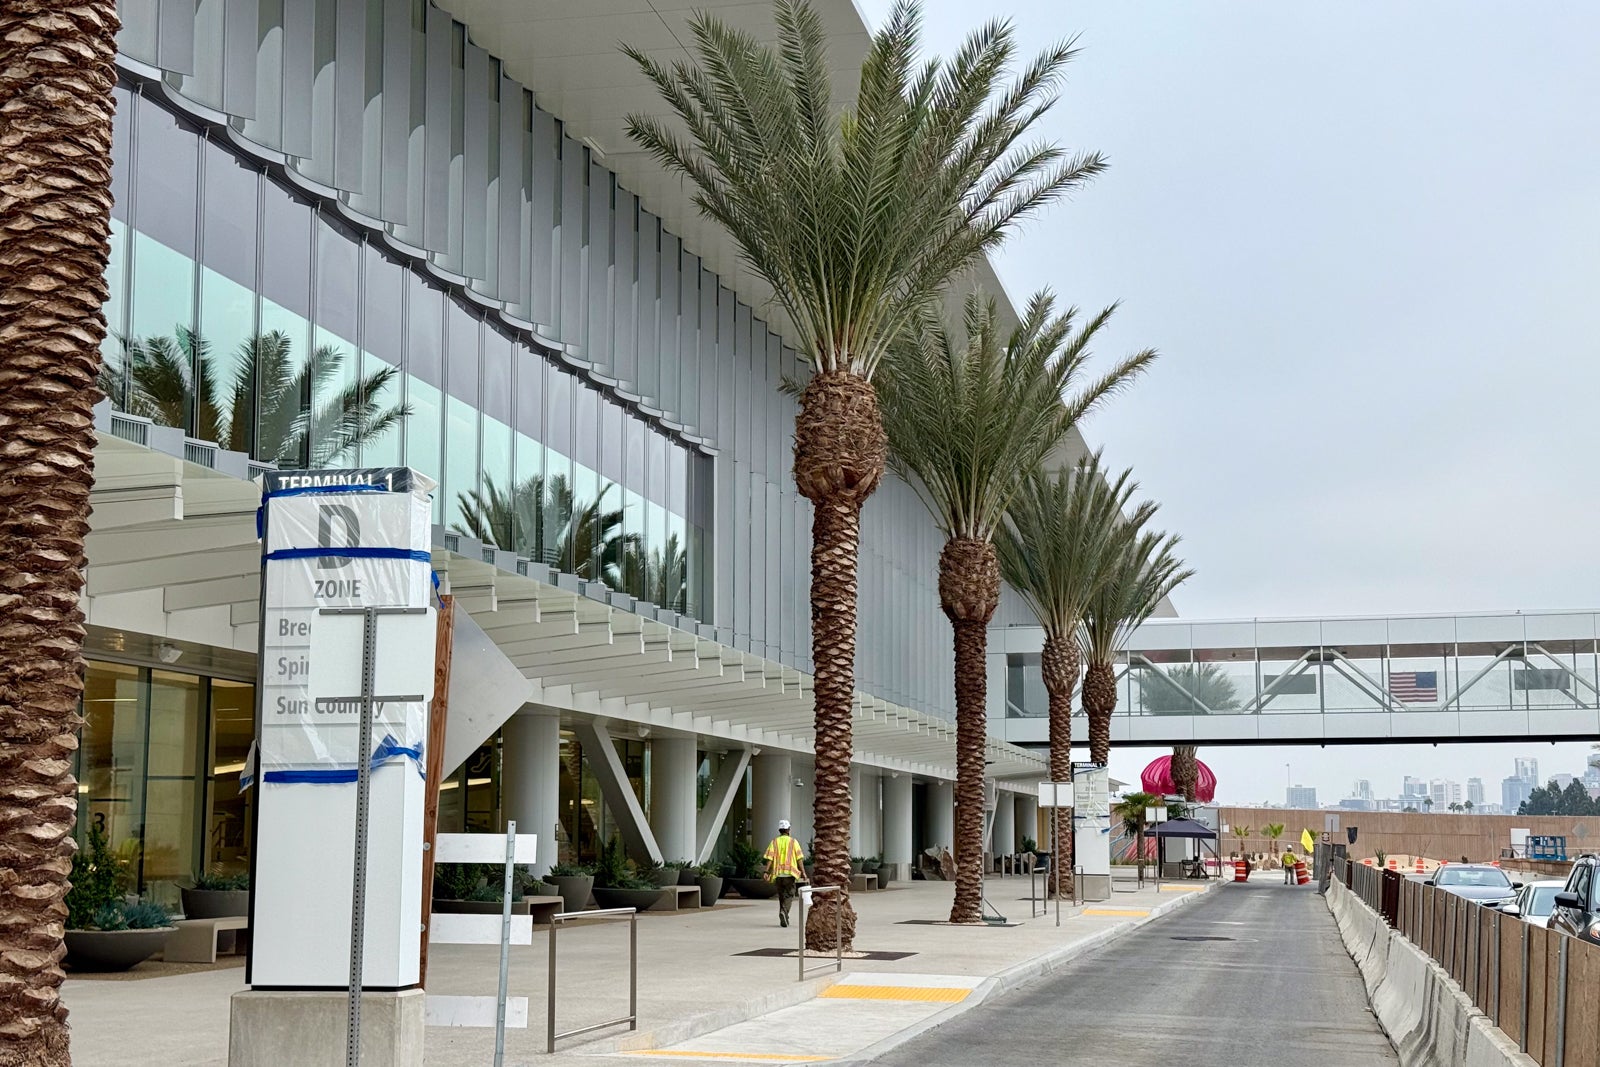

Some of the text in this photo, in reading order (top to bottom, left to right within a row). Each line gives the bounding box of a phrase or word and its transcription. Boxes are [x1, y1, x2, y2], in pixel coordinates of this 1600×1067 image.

[385, 473, 394, 491] 1
[317, 504, 360, 569] D
[314, 580, 361, 599] ZONE
[279, 618, 311, 637] Bre
[276, 696, 384, 719] Sun Couny
